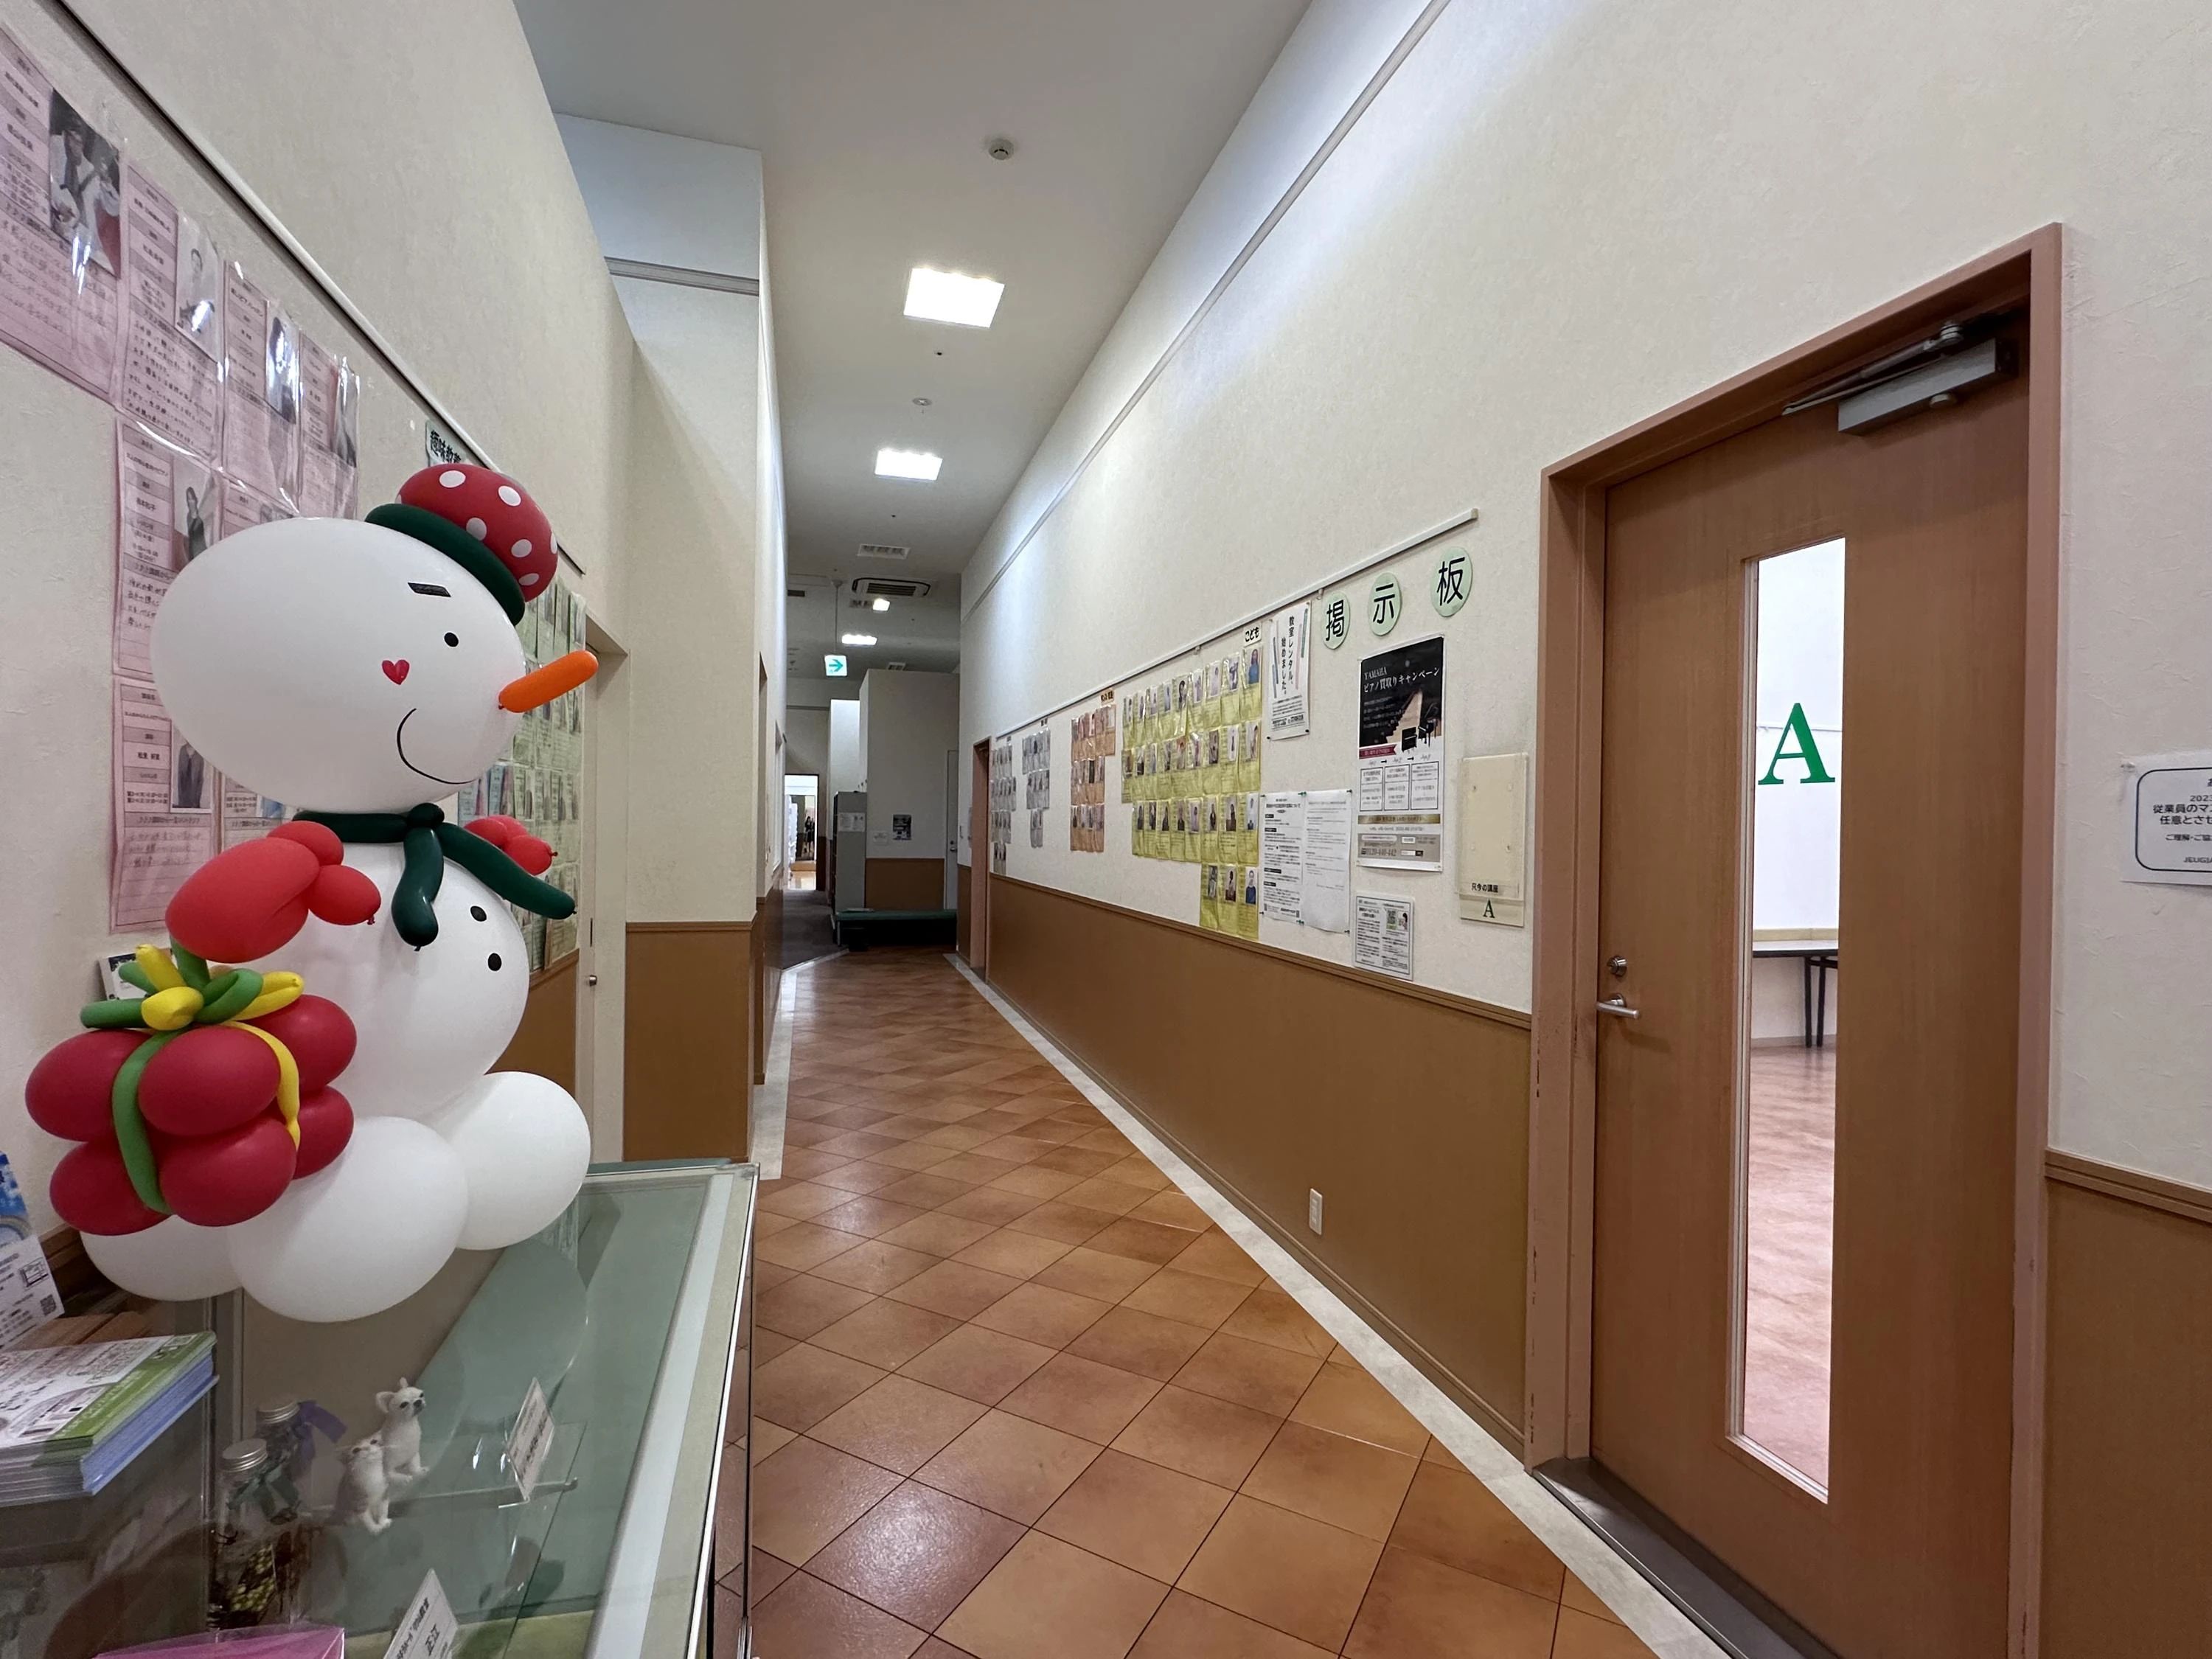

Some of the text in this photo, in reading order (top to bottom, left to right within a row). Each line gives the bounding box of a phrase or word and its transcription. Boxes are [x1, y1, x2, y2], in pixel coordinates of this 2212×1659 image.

[1245, 627, 1260, 642] こども
[1364, 666, 1388, 681] YAMAHA
[1758, 703, 1836, 785] A
[2153, 804, 2212, 814] 従業員のマ
[1483, 899, 1495, 919] A
